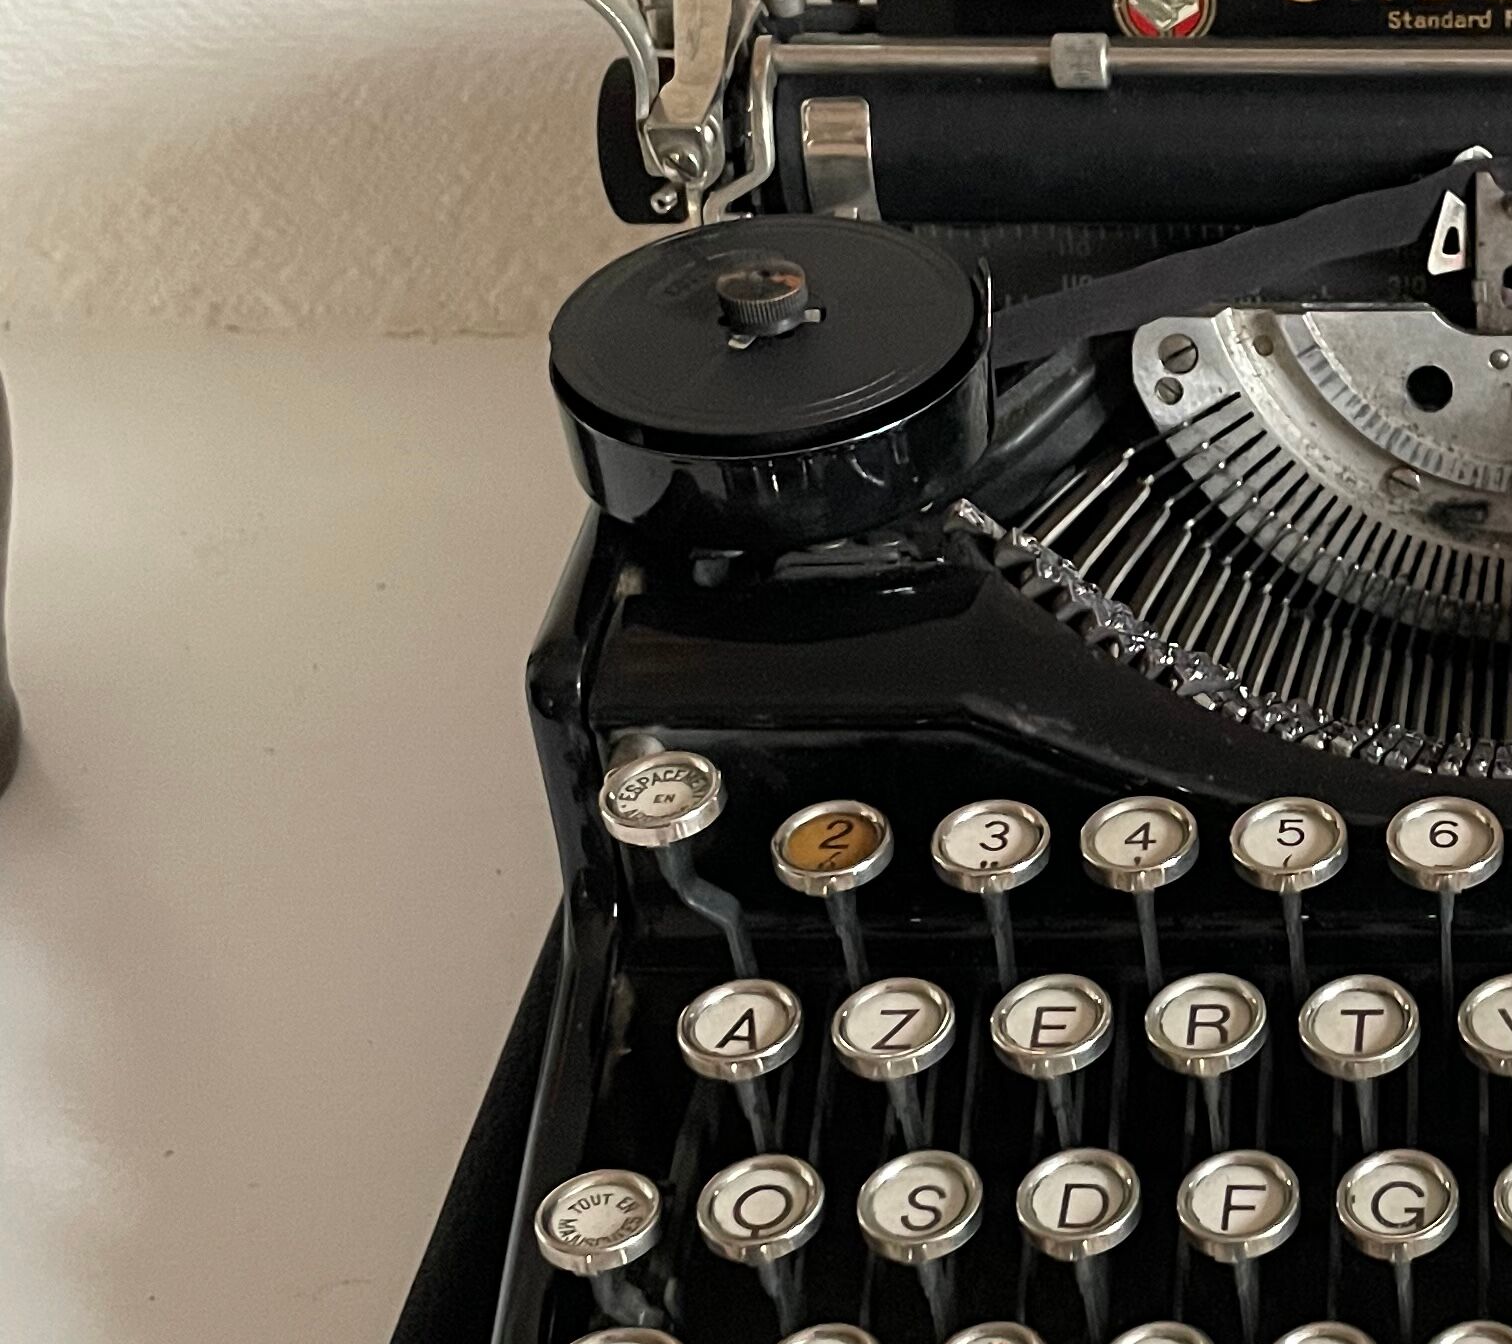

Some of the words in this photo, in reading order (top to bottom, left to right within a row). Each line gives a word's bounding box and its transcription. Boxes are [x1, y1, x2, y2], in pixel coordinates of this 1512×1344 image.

[1388, 9, 1492, 30] Standard
[643, 793, 675, 803] EN
[818, 819, 854, 849] 2
[979, 821, 1009, 852] 3
[1124, 822, 1157, 851] 4
[1277, 819, 1305, 847] 5
[1428, 820, 1459, 849] 6
[715, 1008, 757, 1051] A
[872, 1010, 919, 1051] Z
[1031, 1007, 1075, 1048] E
[1186, 1004, 1229, 1045] R
[1340, 1008, 1384, 1052] T
[568, 1193, 614, 1214] TOUT
[900, 1186, 942, 1231] S
[1058, 1183, 1109, 1228] D
[1221, 1185, 1266, 1230] F
[1371, 1181, 1424, 1228] G
